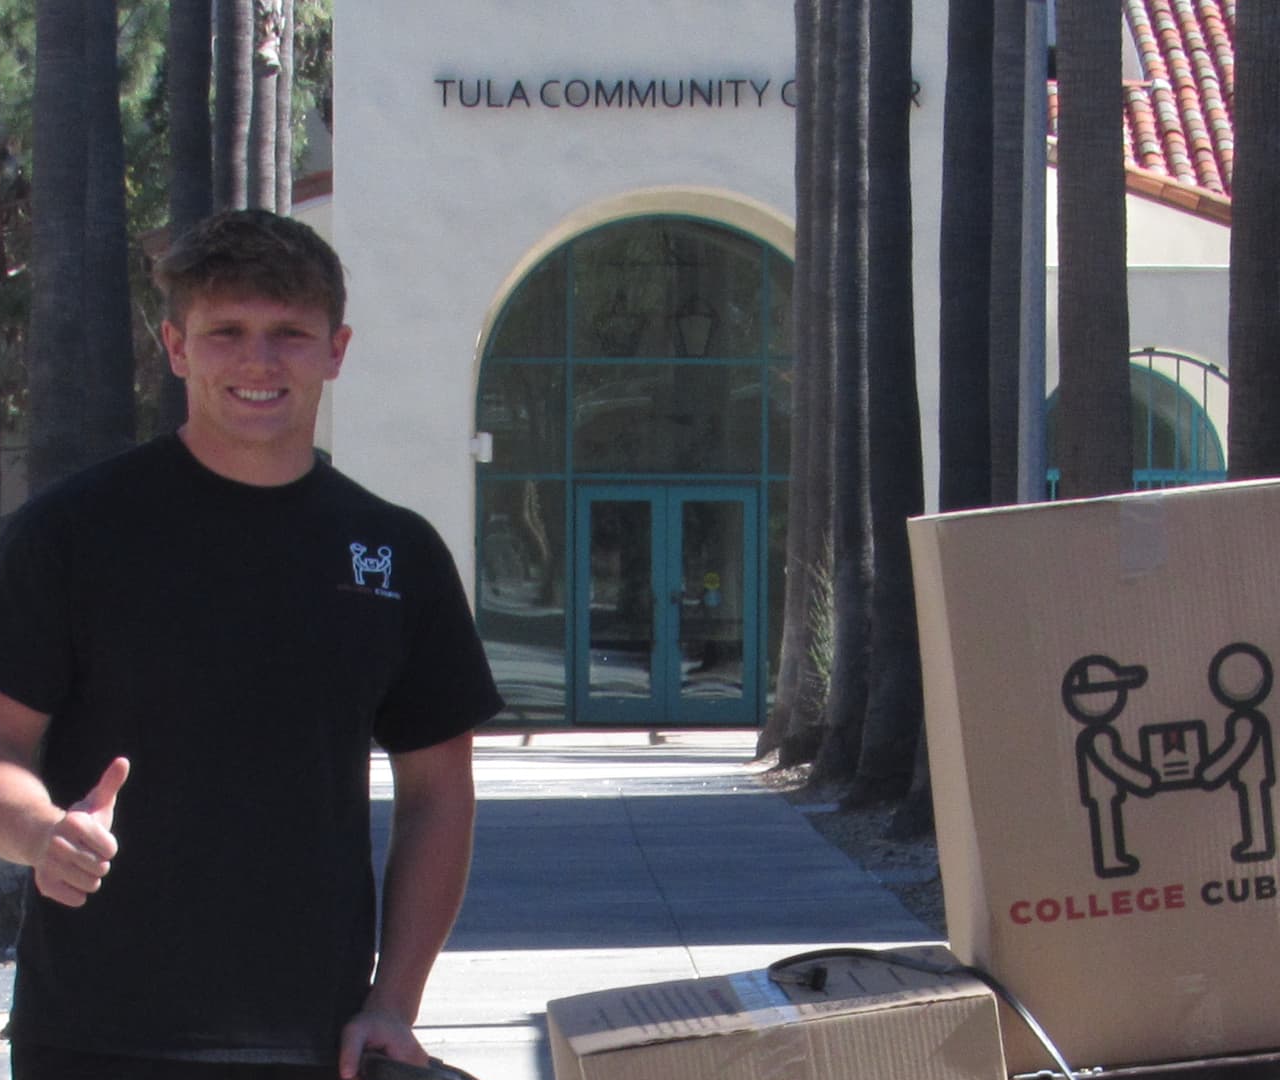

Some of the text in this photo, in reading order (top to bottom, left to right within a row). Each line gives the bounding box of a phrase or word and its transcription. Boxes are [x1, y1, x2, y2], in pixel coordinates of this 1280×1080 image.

[434, 79, 531, 108] TULA
[539, 79, 771, 108] COMMUNITY
[1009, 883, 1186, 925] COLLEGE
